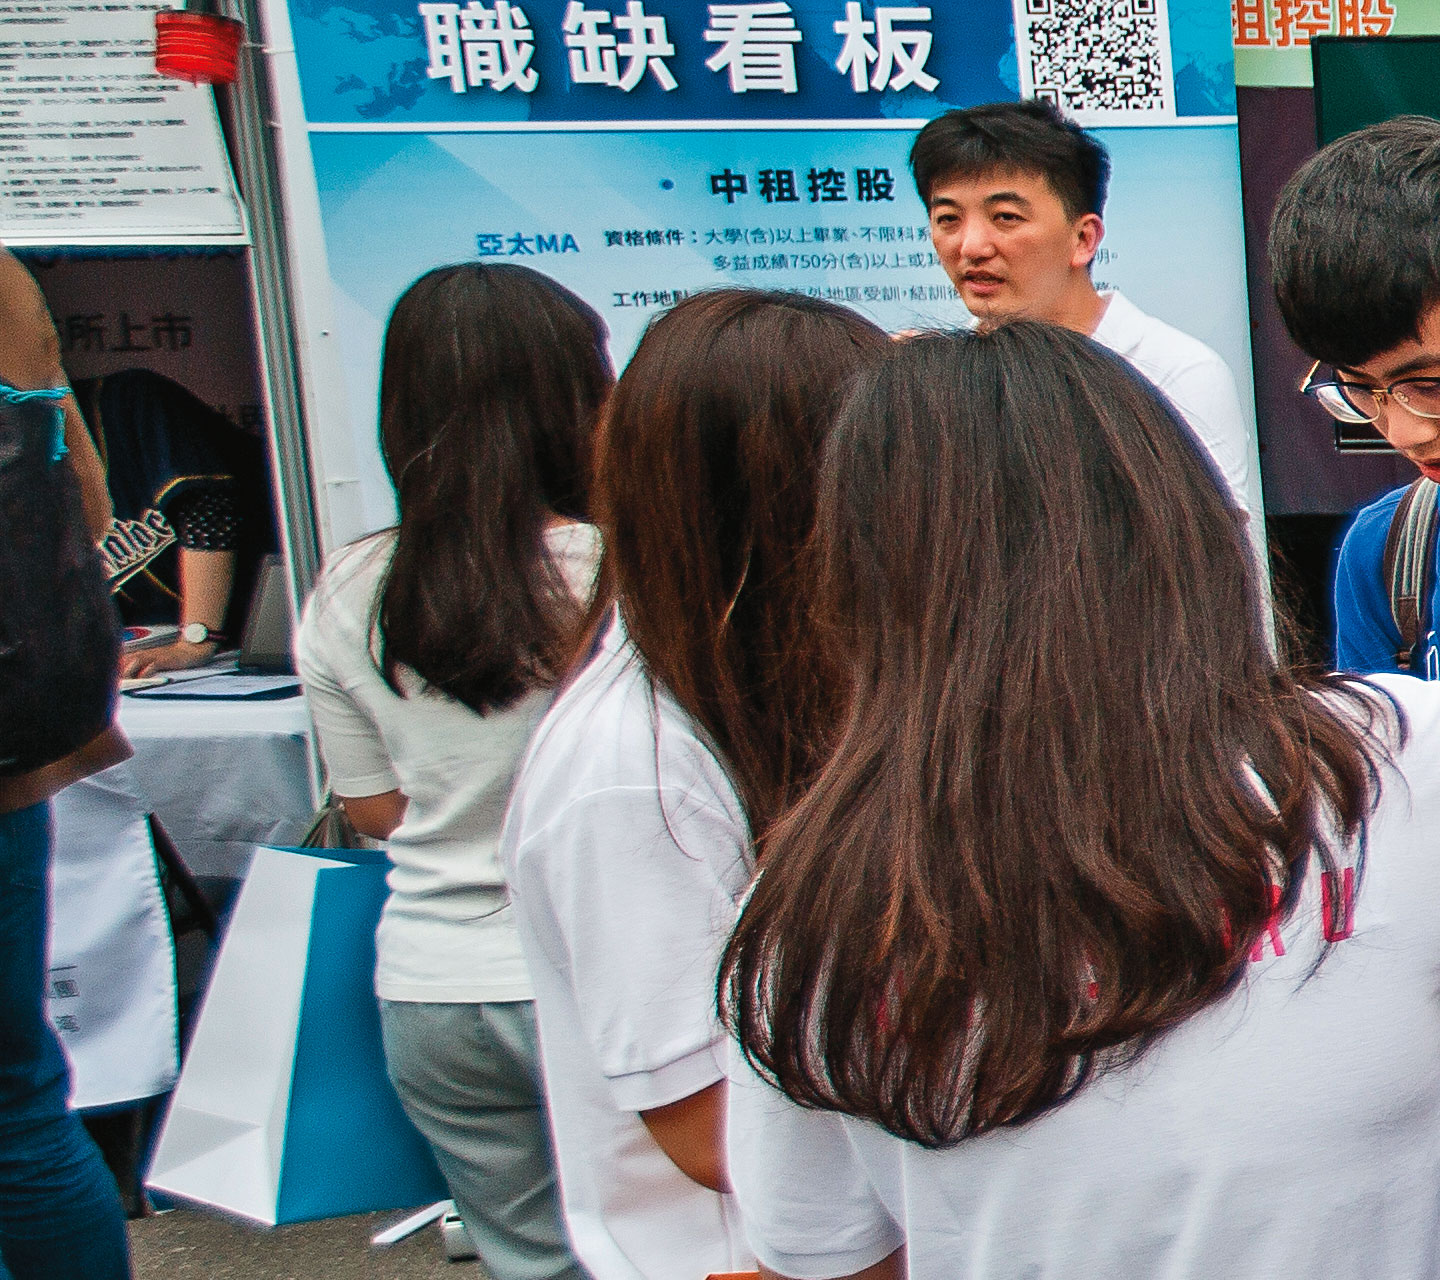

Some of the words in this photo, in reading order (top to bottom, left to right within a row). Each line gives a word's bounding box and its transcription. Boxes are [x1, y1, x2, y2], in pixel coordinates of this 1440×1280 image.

[417, 0, 940, 94] 職缺看板
[711, 167, 895, 204] 中租控股
[477, 231, 580, 257] 亞太MA
